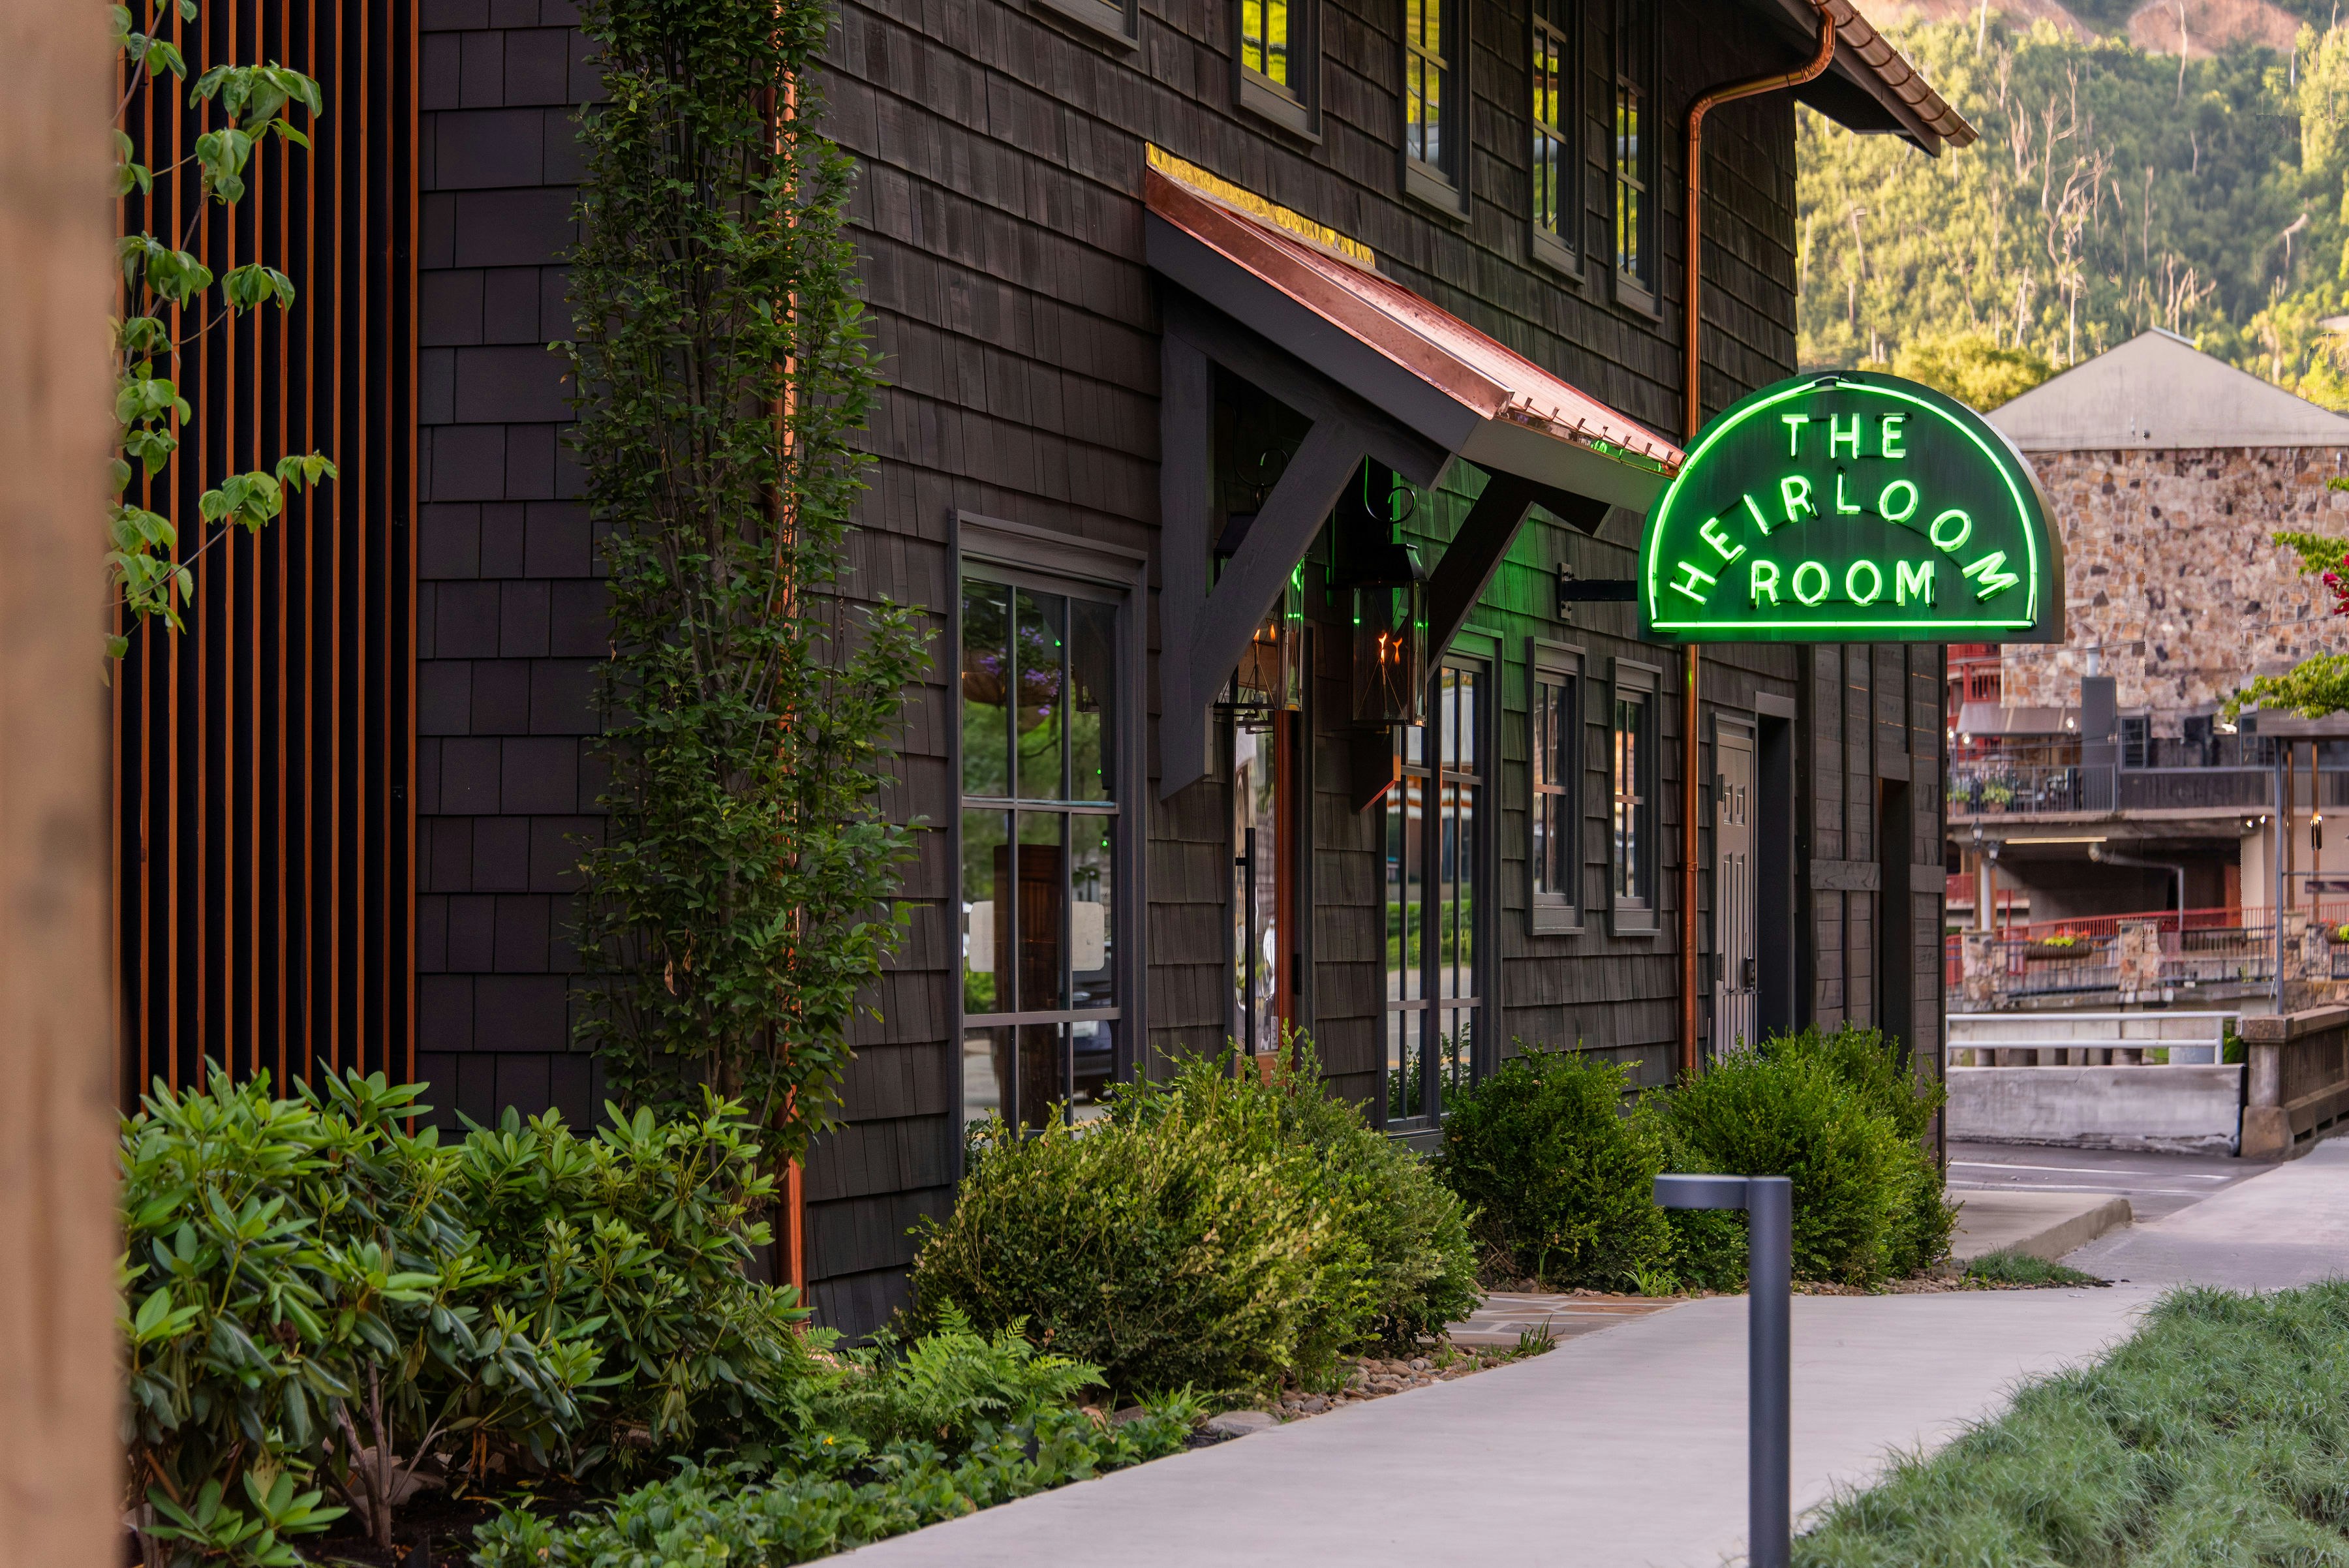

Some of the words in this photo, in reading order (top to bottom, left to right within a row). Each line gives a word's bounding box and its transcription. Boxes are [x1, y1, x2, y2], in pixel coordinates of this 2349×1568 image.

[1781, 413, 1905, 459] THE
[1670, 467, 2018, 604] HEIRLOOM
[1751, 559, 1935, 606] ROOM
